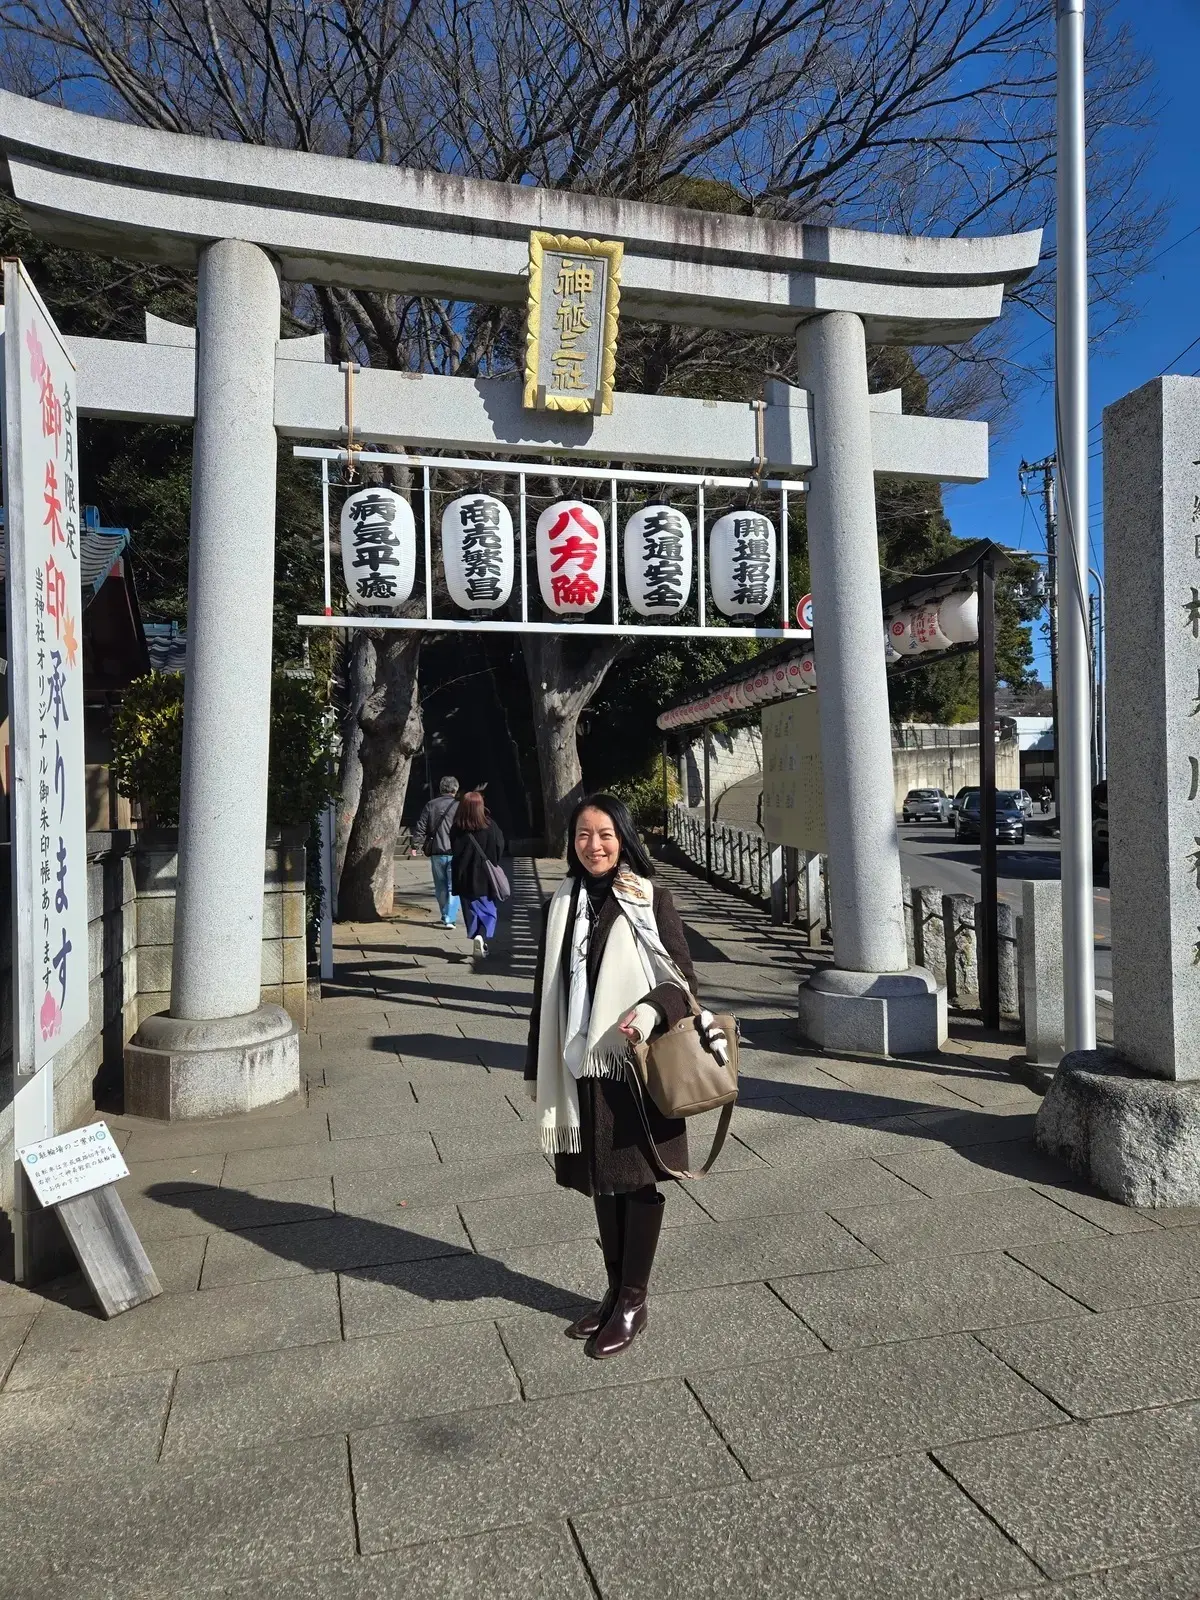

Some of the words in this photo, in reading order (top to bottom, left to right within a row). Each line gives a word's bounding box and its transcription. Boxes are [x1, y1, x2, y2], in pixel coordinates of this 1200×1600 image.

[62, 381, 78, 560] 各月限定
[349, 495, 400, 599] 病気平癒
[460, 499, 503, 602] 商売繁昌
[548, 506, 600, 607] 八方除
[643, 511, 684, 608] 交通安全
[732, 517, 770, 605] 開運招福
[39, 364, 73, 1011] 御朱印承ります
[34, 566, 53, 992] 当神社オリジナル御朱印帳あります
[39, 1135, 96, 1159] 駐輪場のご案内
